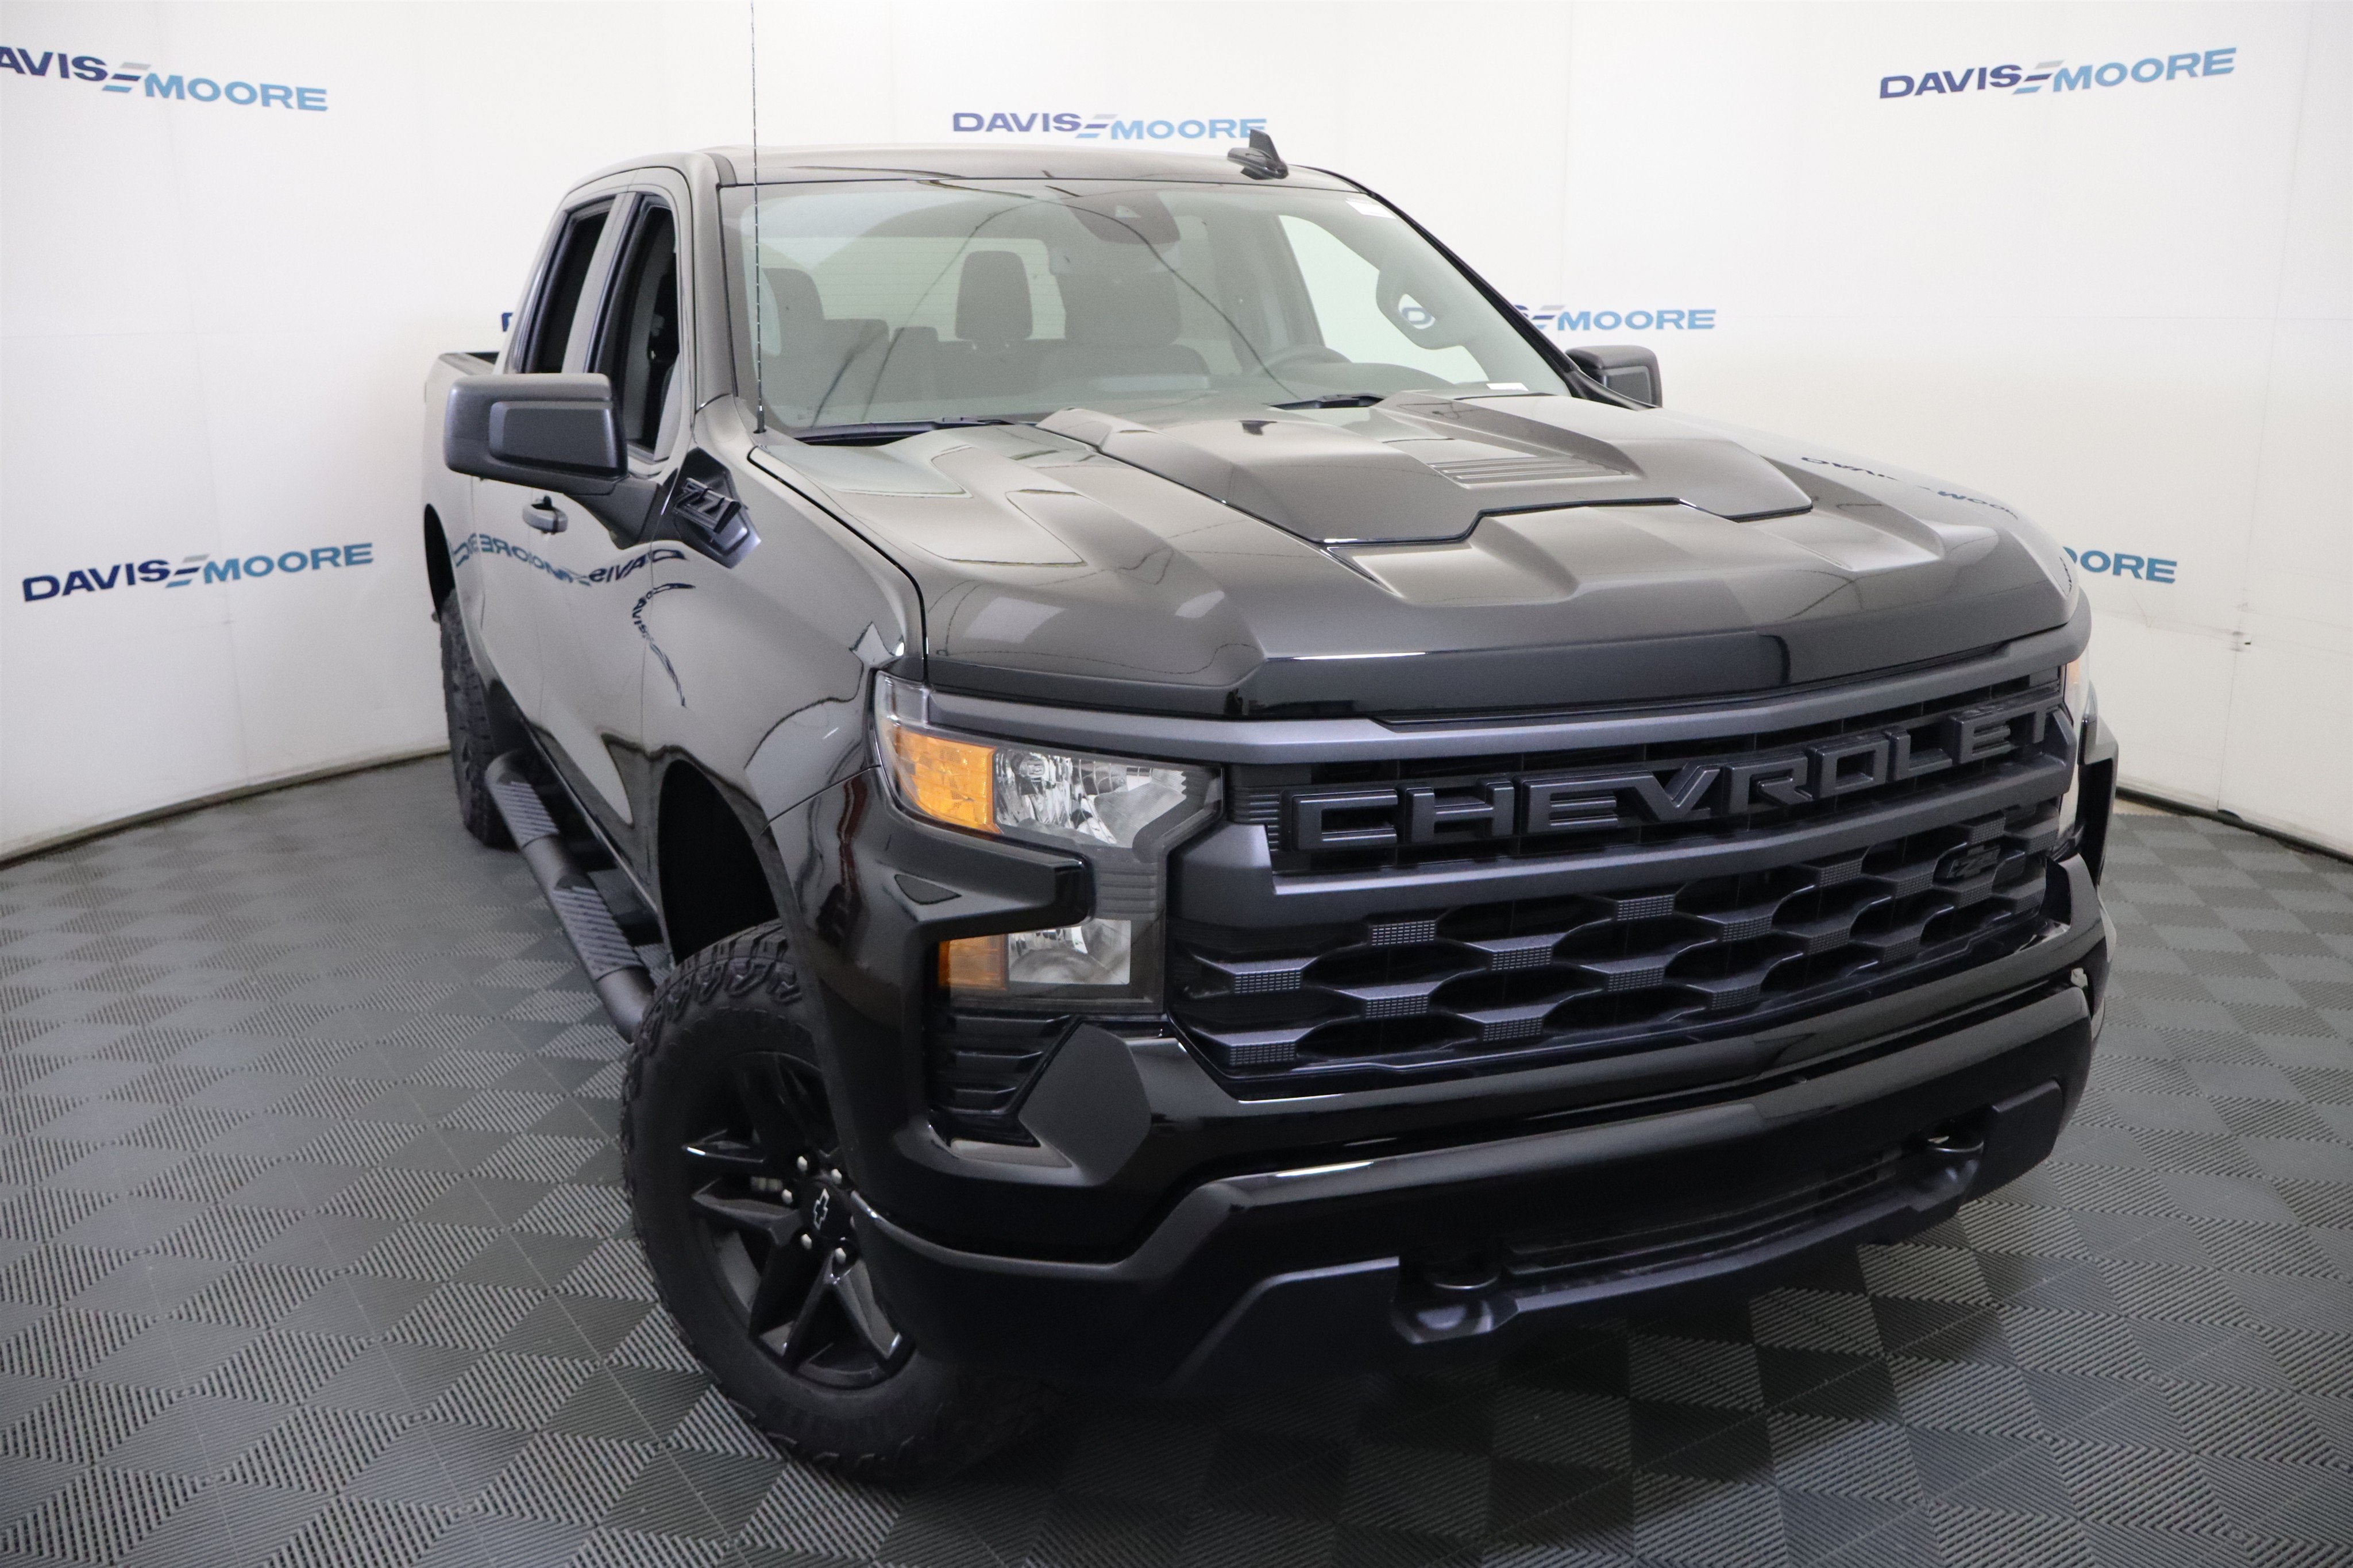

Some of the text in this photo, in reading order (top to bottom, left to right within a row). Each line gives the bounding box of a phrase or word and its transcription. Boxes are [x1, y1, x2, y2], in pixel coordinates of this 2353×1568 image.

[0, 45, 328, 112] AVIS MOORE
[1878, 47, 2237, 100] DAVIS MOORE
[952, 113, 1081, 133] DAVIS
[1557, 309, 1716, 331] MOORE
[21, 542, 375, 603] DAVIS MOORE
[2062, 546, 2178, 585] ORE
[1286, 692, 2061, 851] CHEVROLET
